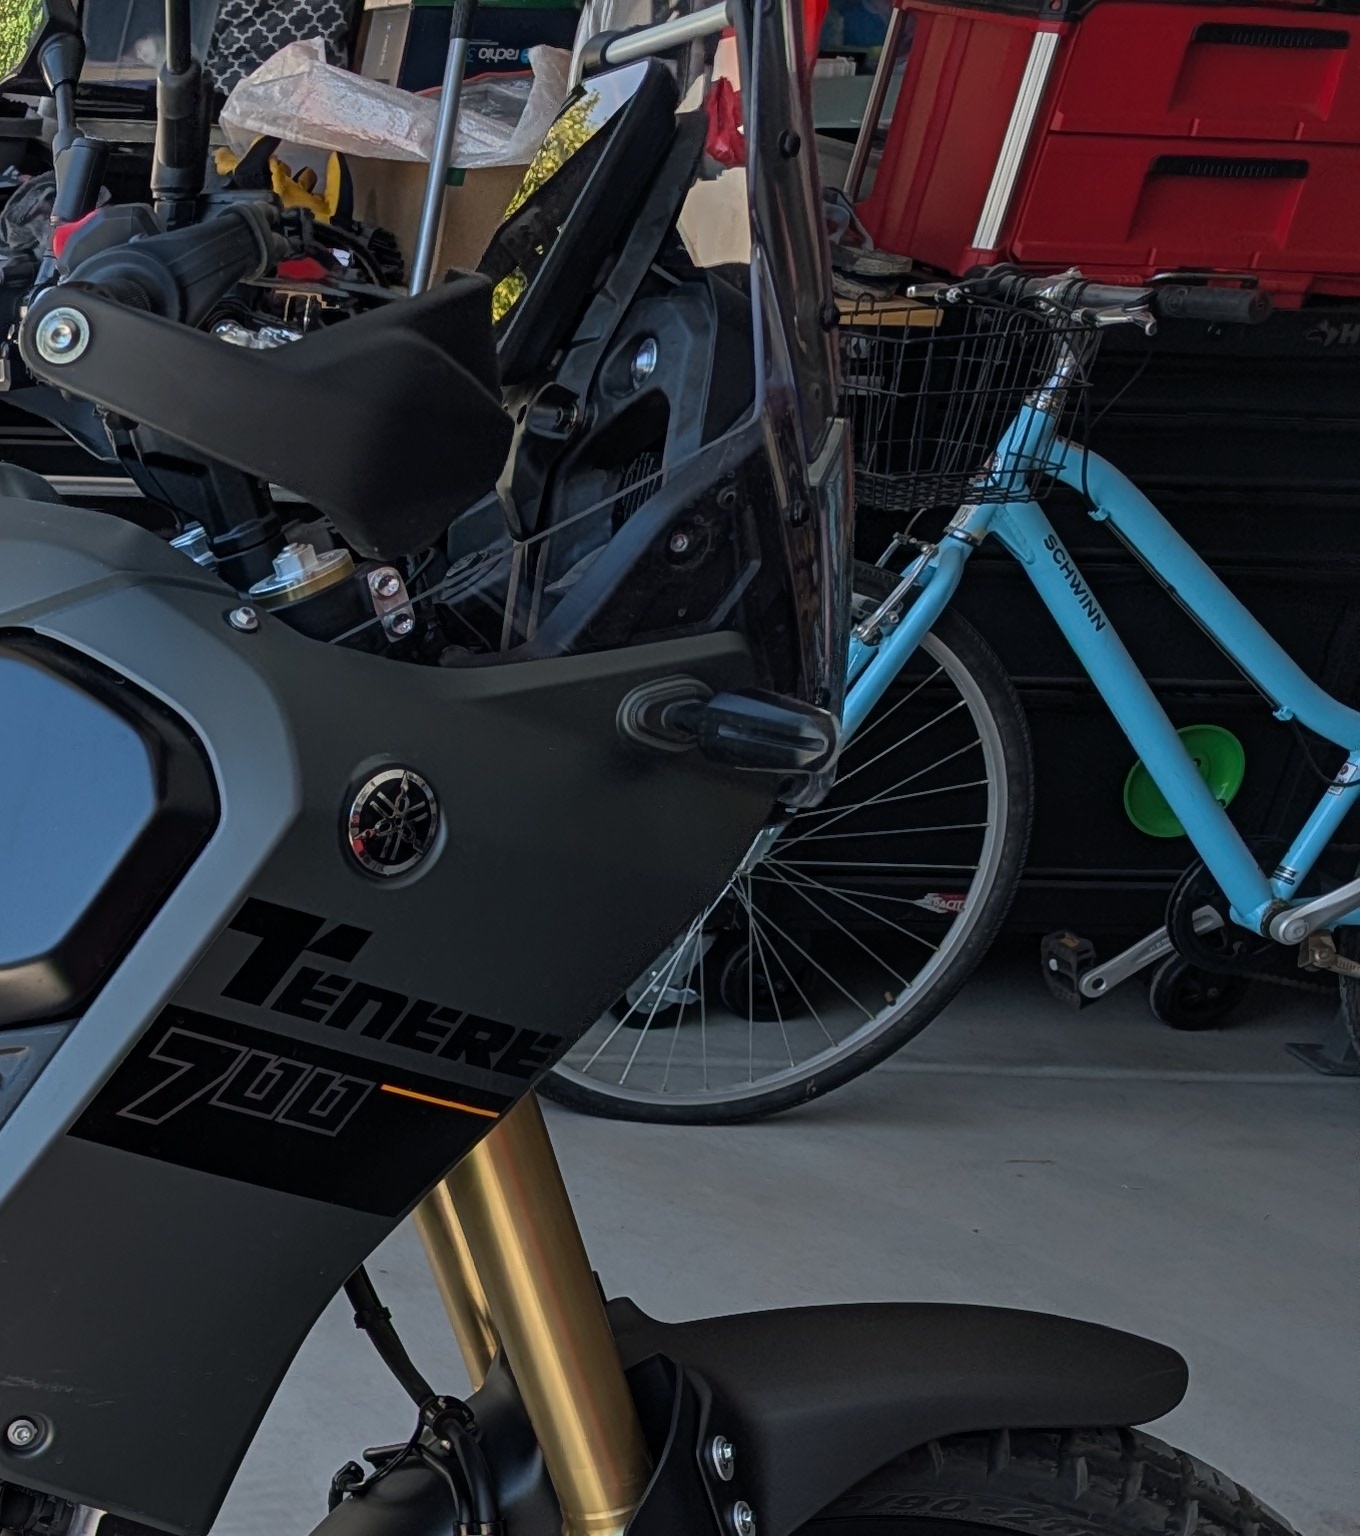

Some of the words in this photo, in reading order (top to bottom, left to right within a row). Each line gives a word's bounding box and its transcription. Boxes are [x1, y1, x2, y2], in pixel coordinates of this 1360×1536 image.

[478, 47, 520, 63] rachio
[1043, 533, 1107, 632] SCHWINN
[116, 1027, 377, 1138] 700
